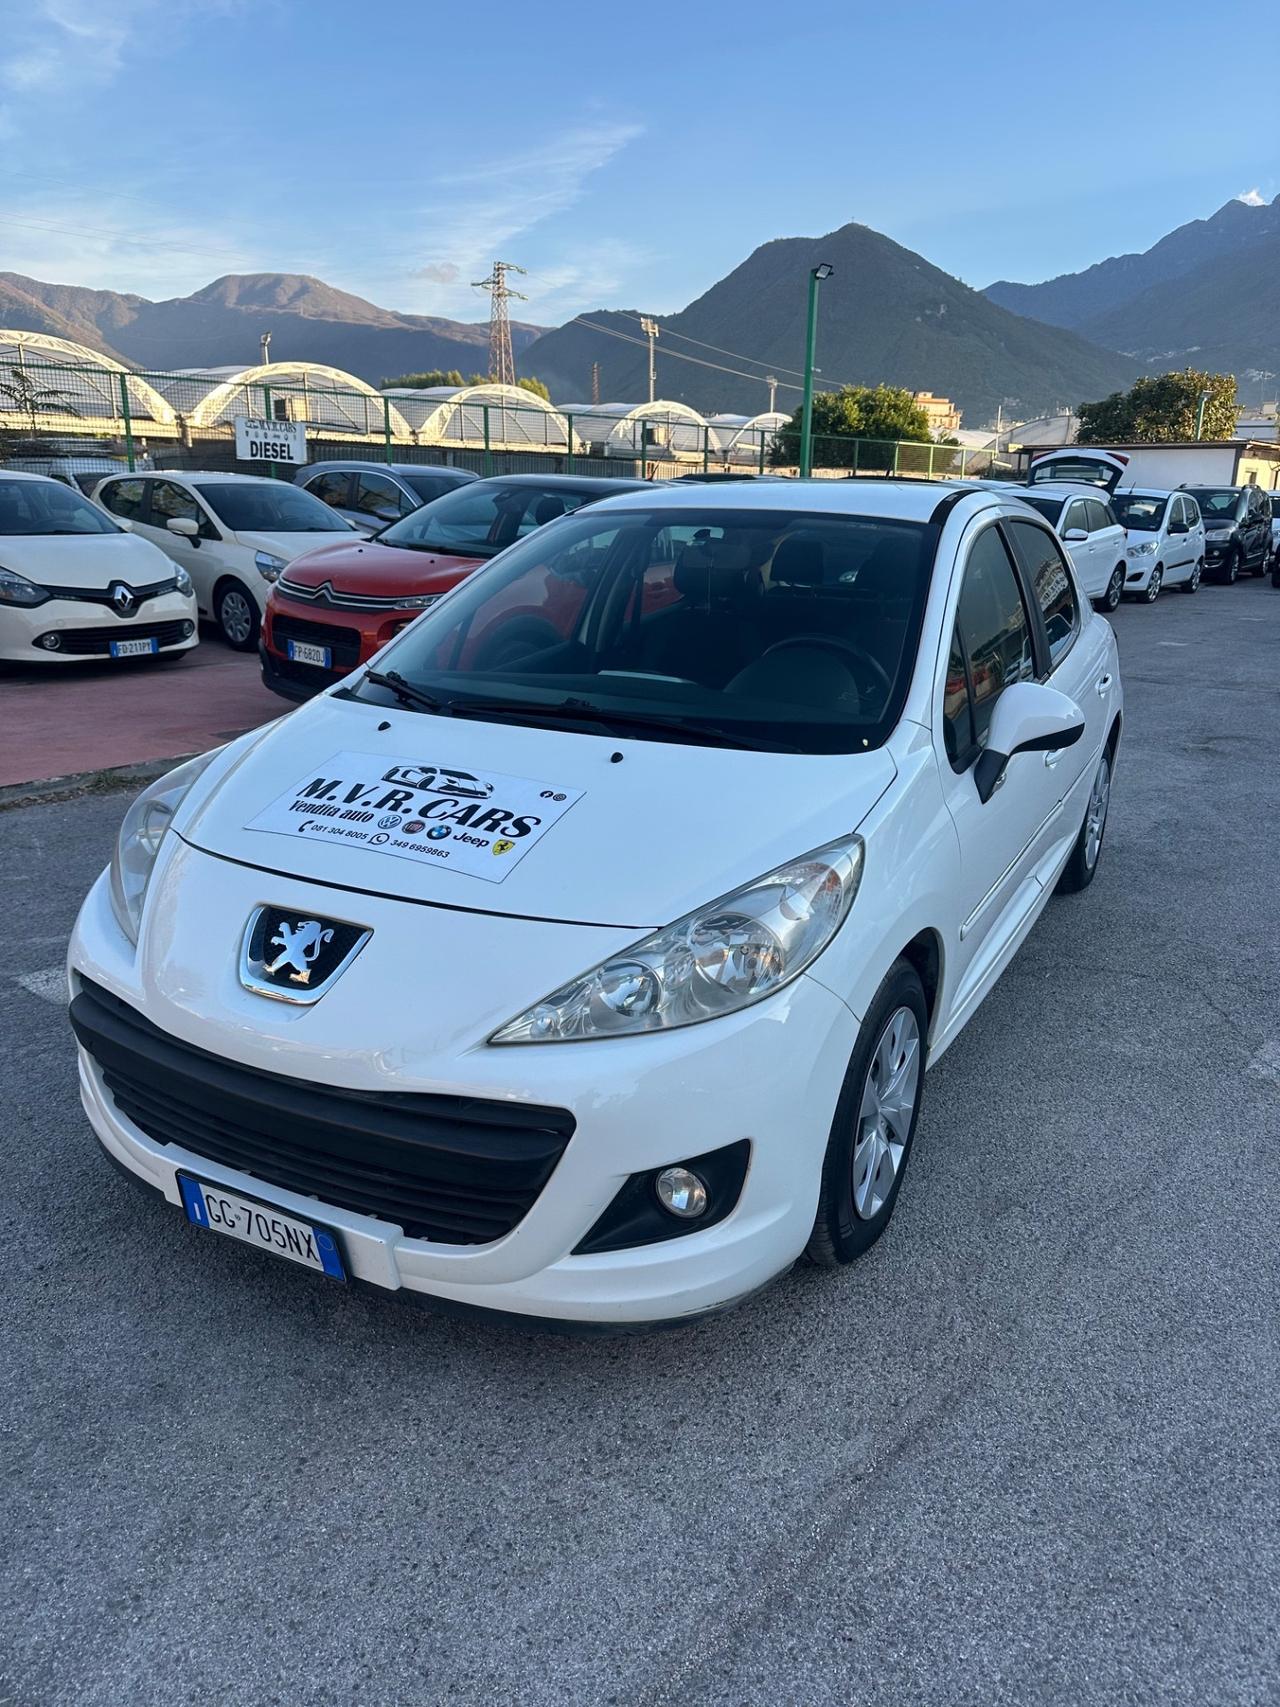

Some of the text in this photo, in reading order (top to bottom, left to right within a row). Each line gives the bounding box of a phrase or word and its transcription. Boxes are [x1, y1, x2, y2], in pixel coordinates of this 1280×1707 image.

[250, 440, 294, 460] DIESEL
[288, 799, 375, 823] Vendita auto
[418, 798, 542, 838] CARS
[390, 839, 409, 849] 349
[453, 832, 490, 848] Jeep
